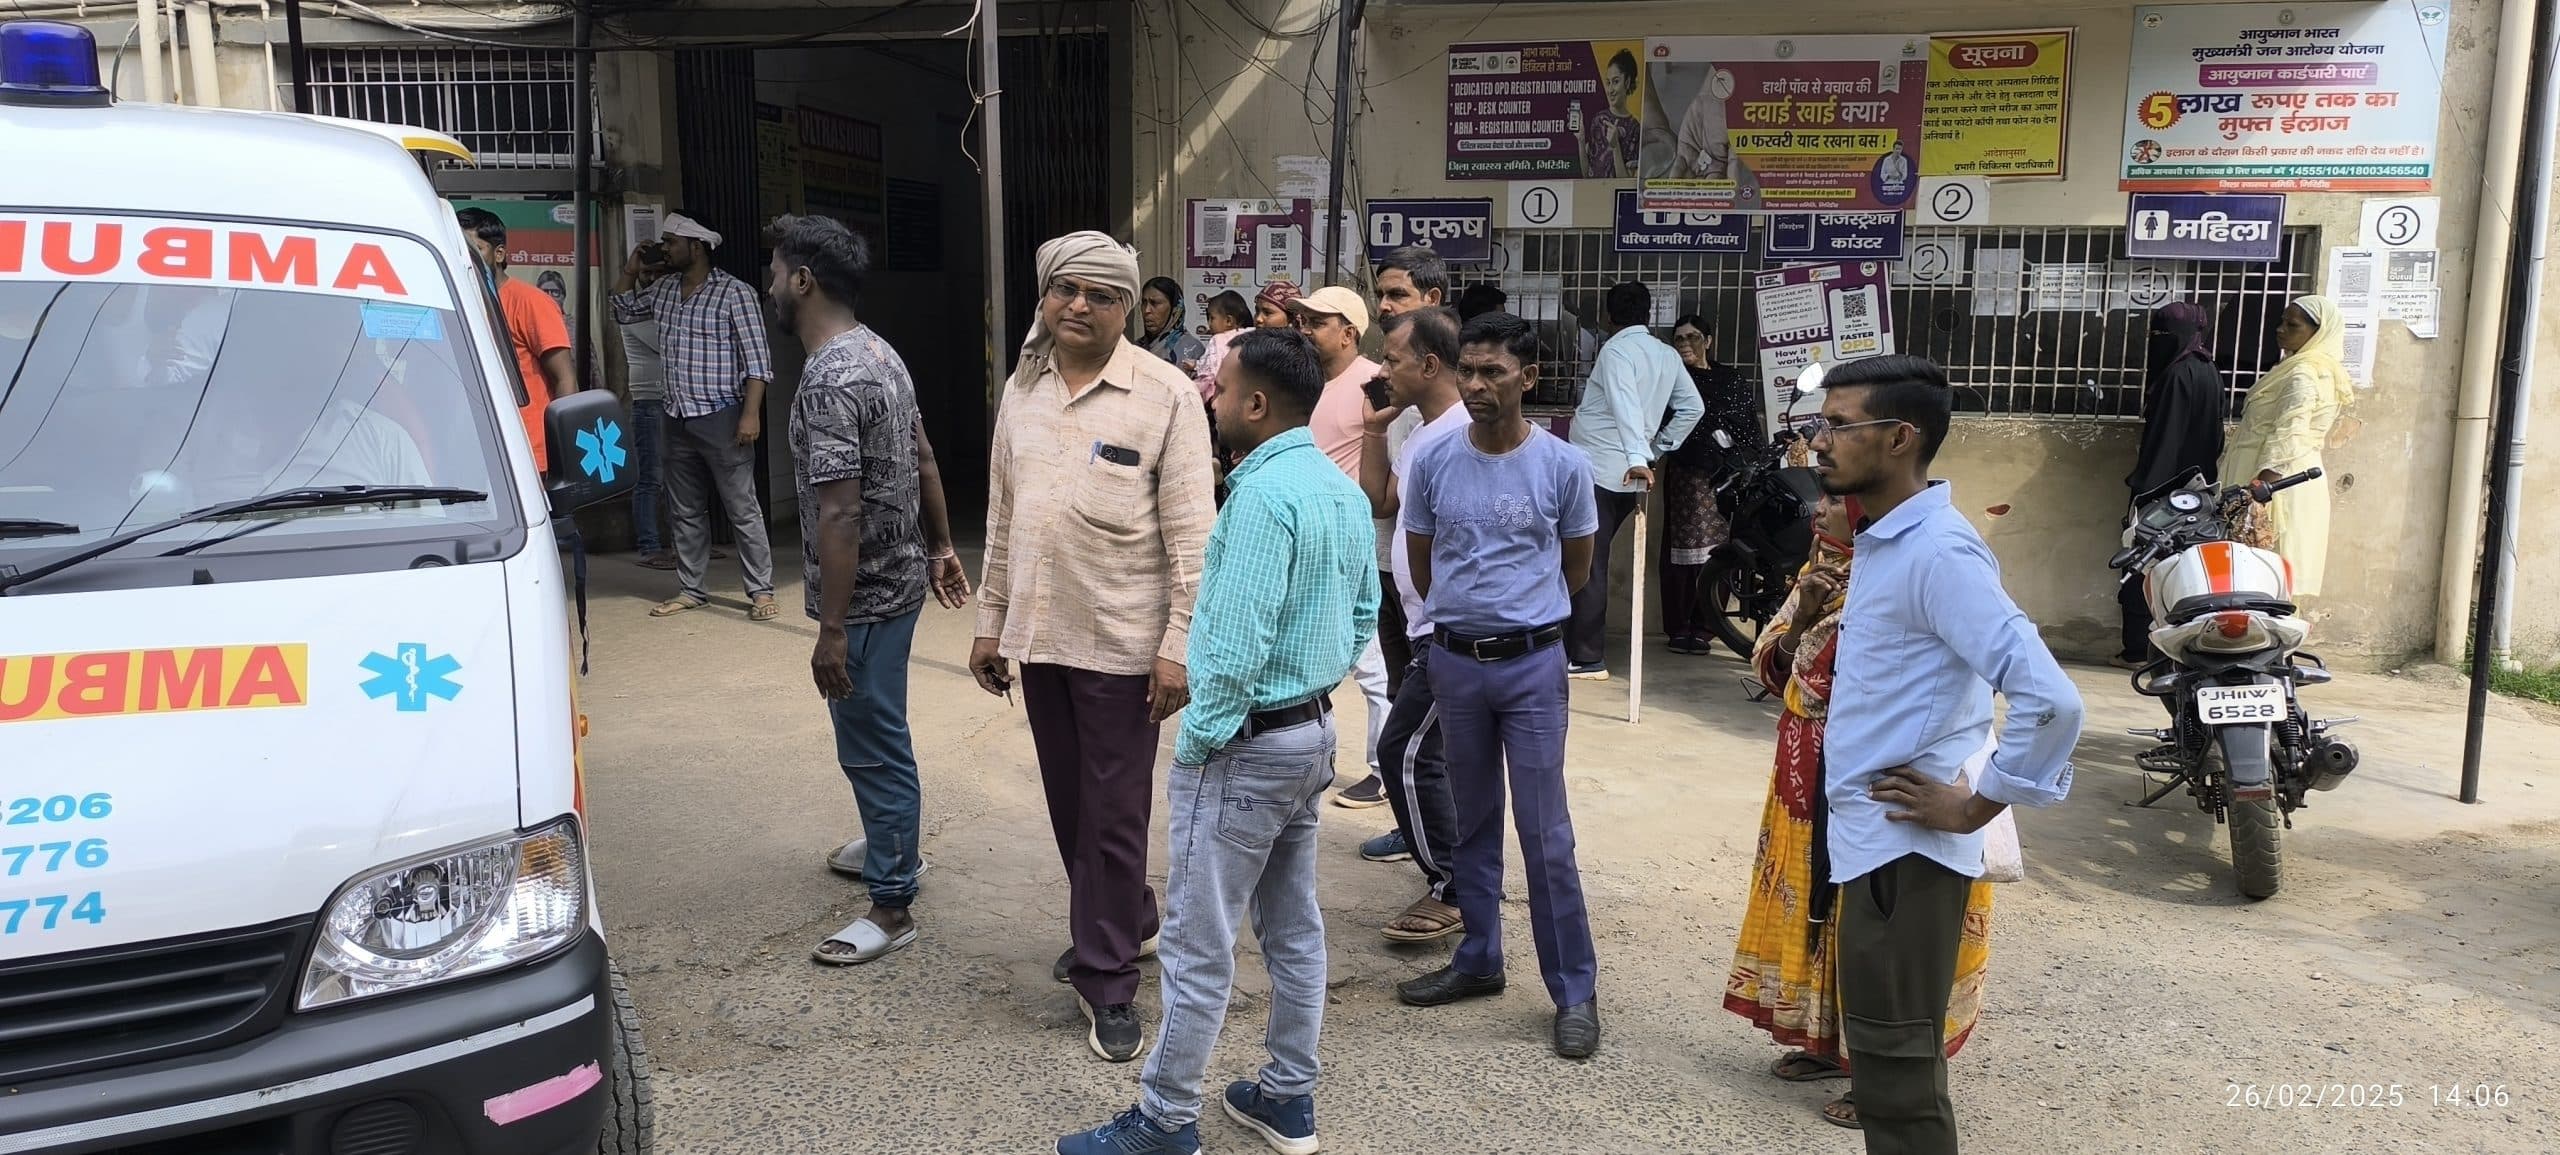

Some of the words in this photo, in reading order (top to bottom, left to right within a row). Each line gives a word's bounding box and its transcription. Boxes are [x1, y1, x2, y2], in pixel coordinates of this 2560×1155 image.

[2239, 28, 2301, 43] आयुष्मान
[2304, 28, 2339, 39] भारत
[1961, 45, 2026, 66] सूचना
[2193, 43, 2252, 60] मुख्यमंत्री
[2257, 46, 2282, 56] जन
[2285, 43, 2335, 56] आरोग्य
[2338, 43, 2384, 56] योजना
[1996, 77, 2028, 86] अस्पताल
[2031, 75, 2059, 85] गिरिडीह
[2208, 68, 2274, 85] आयुष्मान
[2277, 65, 2338, 81] कार्डधारी
[1455, 82, 1493, 96] DEDICATED
[1494, 82, 1509, 95] OPD
[1511, 81, 1562, 95] REGISTRATION
[1564, 80, 1596, 93] COUNTER
[1762, 78, 1786, 95] हाथी
[1812, 78, 1822, 94] से
[1824, 81, 1854, 94] बचाव
[1856, 78, 1872, 94] की
[1934, 93, 1948, 101] रक्त
[1952, 91, 1964, 100] लेने
[1969, 91, 1982, 100] और
[1985, 91, 1996, 99] देने
[1999, 90, 2010, 101] हेतु
[2013, 90, 2043, 98] रक्तदाता
[2047, 88, 2058, 100] एवं
[1454, 102, 1472, 115] HELP
[1478, 102, 1496, 115] DESK
[1499, 101, 1530, 114] COUNTER
[1743, 95, 1792, 124] दवाई
[1796, 95, 1838, 124] खाई
[1841, 102, 1890, 122] क्या?
[1924, 106, 1938, 114] रक्त
[1960, 103, 1977, 113] करने
[1980, 103, 1996, 113] वाले
[1999, 102, 2018, 112] मरीज
[2148, 95, 2174, 128] 5
[2177, 94, 2243, 114] लाख
[2315, 92, 2359, 108] तक
[2365, 91, 2399, 107] का
[1454, 122, 1473, 134] ABHA
[1480, 121, 1530, 134] REGISTRATION
[1532, 120, 1564, 133] COUNTER
[1954, 116, 1972, 126] फोटो
[2012, 115, 2028, 124] फोन
[2043, 114, 2056, 124] देना
[2218, 116, 2275, 141] मुफ्त
[2280, 110, 2351, 133] ईलाज
[801, 111, 879, 158] ULTRASOUND
[1735, 135, 1748, 148] 10
[1751, 131, 1793, 148] फरवरी
[1797, 136, 1818, 148] याद
[1823, 135, 1855, 148] रखना
[1859, 135, 1878, 147] बस
[2242, 145, 2267, 157] किसी
[2270, 147, 2298, 157] प्रकार
[2300, 145, 2314, 156] की
[1449, 161, 1469, 171] जिला
[1472, 162, 1501, 171] स्वास्थ्य
[2289, 165, 2424, 176] 14555/104/18003456540
[2173, 211, 2272, 242] महिला
[1622, 233, 1649, 244] वरिष्ठ
[511, 250, 528, 263] की
[531, 254, 553, 263] बात
[1766, 327, 1829, 343] QUEUE
[1840, 332, 1873, 340] FASTER
[1841, 339, 1874, 350] OPD
[1775, 349, 1798, 358] How
[1777, 357, 1807, 365] works
[2208, 704, 2275, 719] 6528
[0, 792, 112, 826] 206
[2, 838, 109, 876] 776
[0, 891, 107, 934] 774
